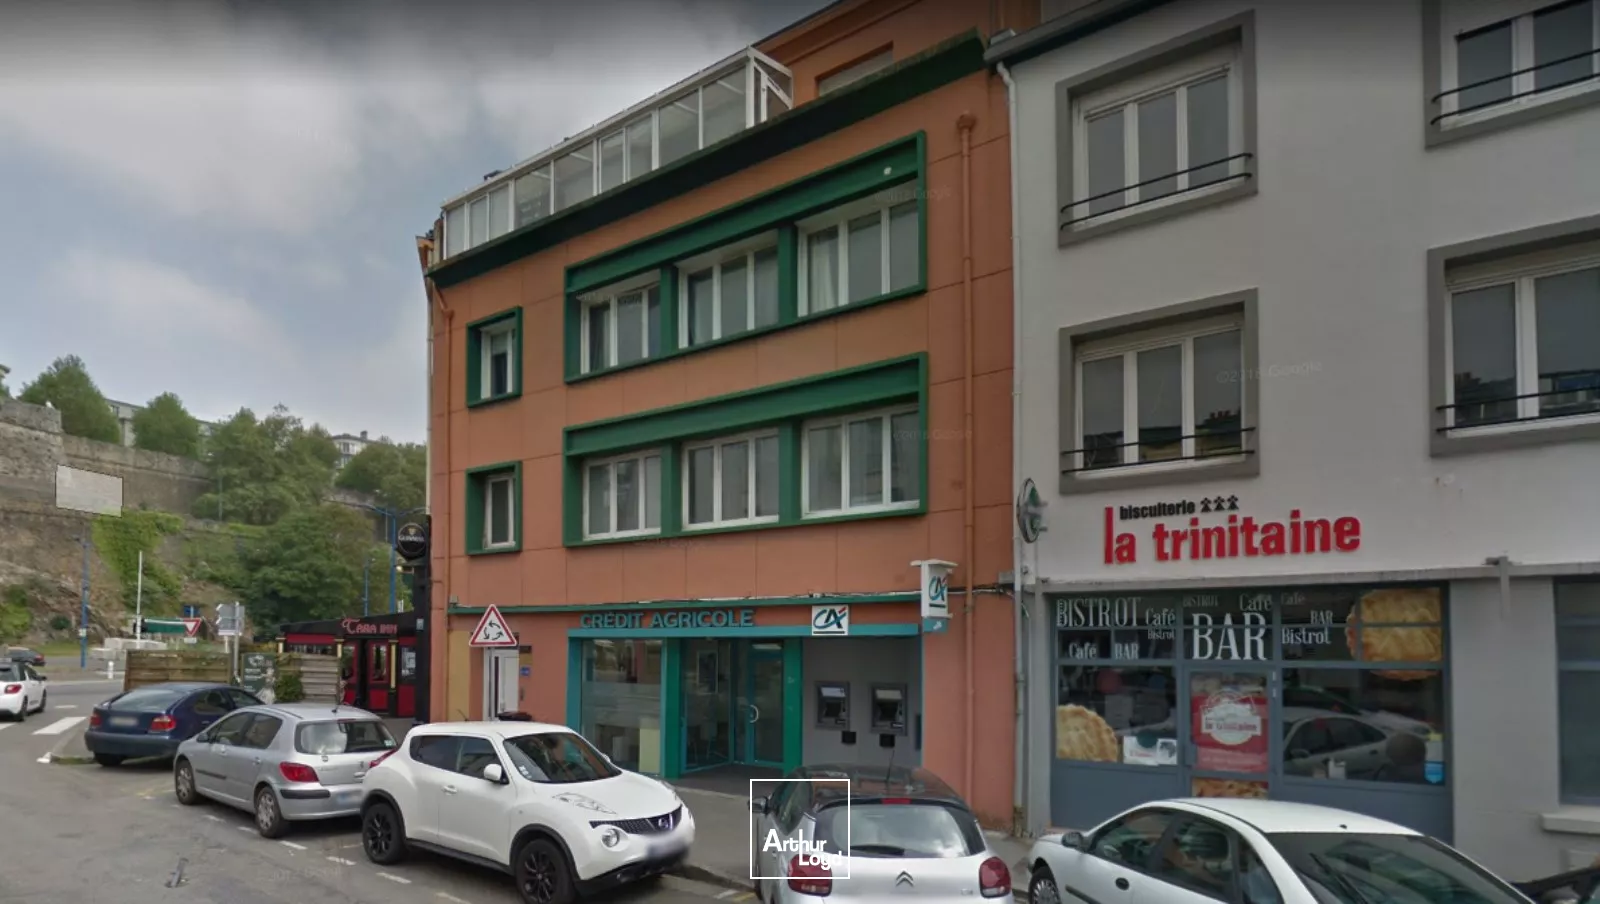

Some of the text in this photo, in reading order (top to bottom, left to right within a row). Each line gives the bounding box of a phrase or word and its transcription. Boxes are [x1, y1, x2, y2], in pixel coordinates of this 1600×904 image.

[1119, 499, 1196, 521] biscuiterie
[1104, 506, 1361, 565] la trinitaine
[650, 609, 755, 628] AGRICOLE
[1056, 597, 1142, 628] BISTROT
[1145, 607, 1176, 626] Café
[1310, 610, 1334, 625] BAR
[1191, 612, 1267, 661] BAR
[1281, 627, 1332, 645] Bistrot
[1069, 642, 1097, 660] Café
[1115, 643, 1139, 660] BAR
